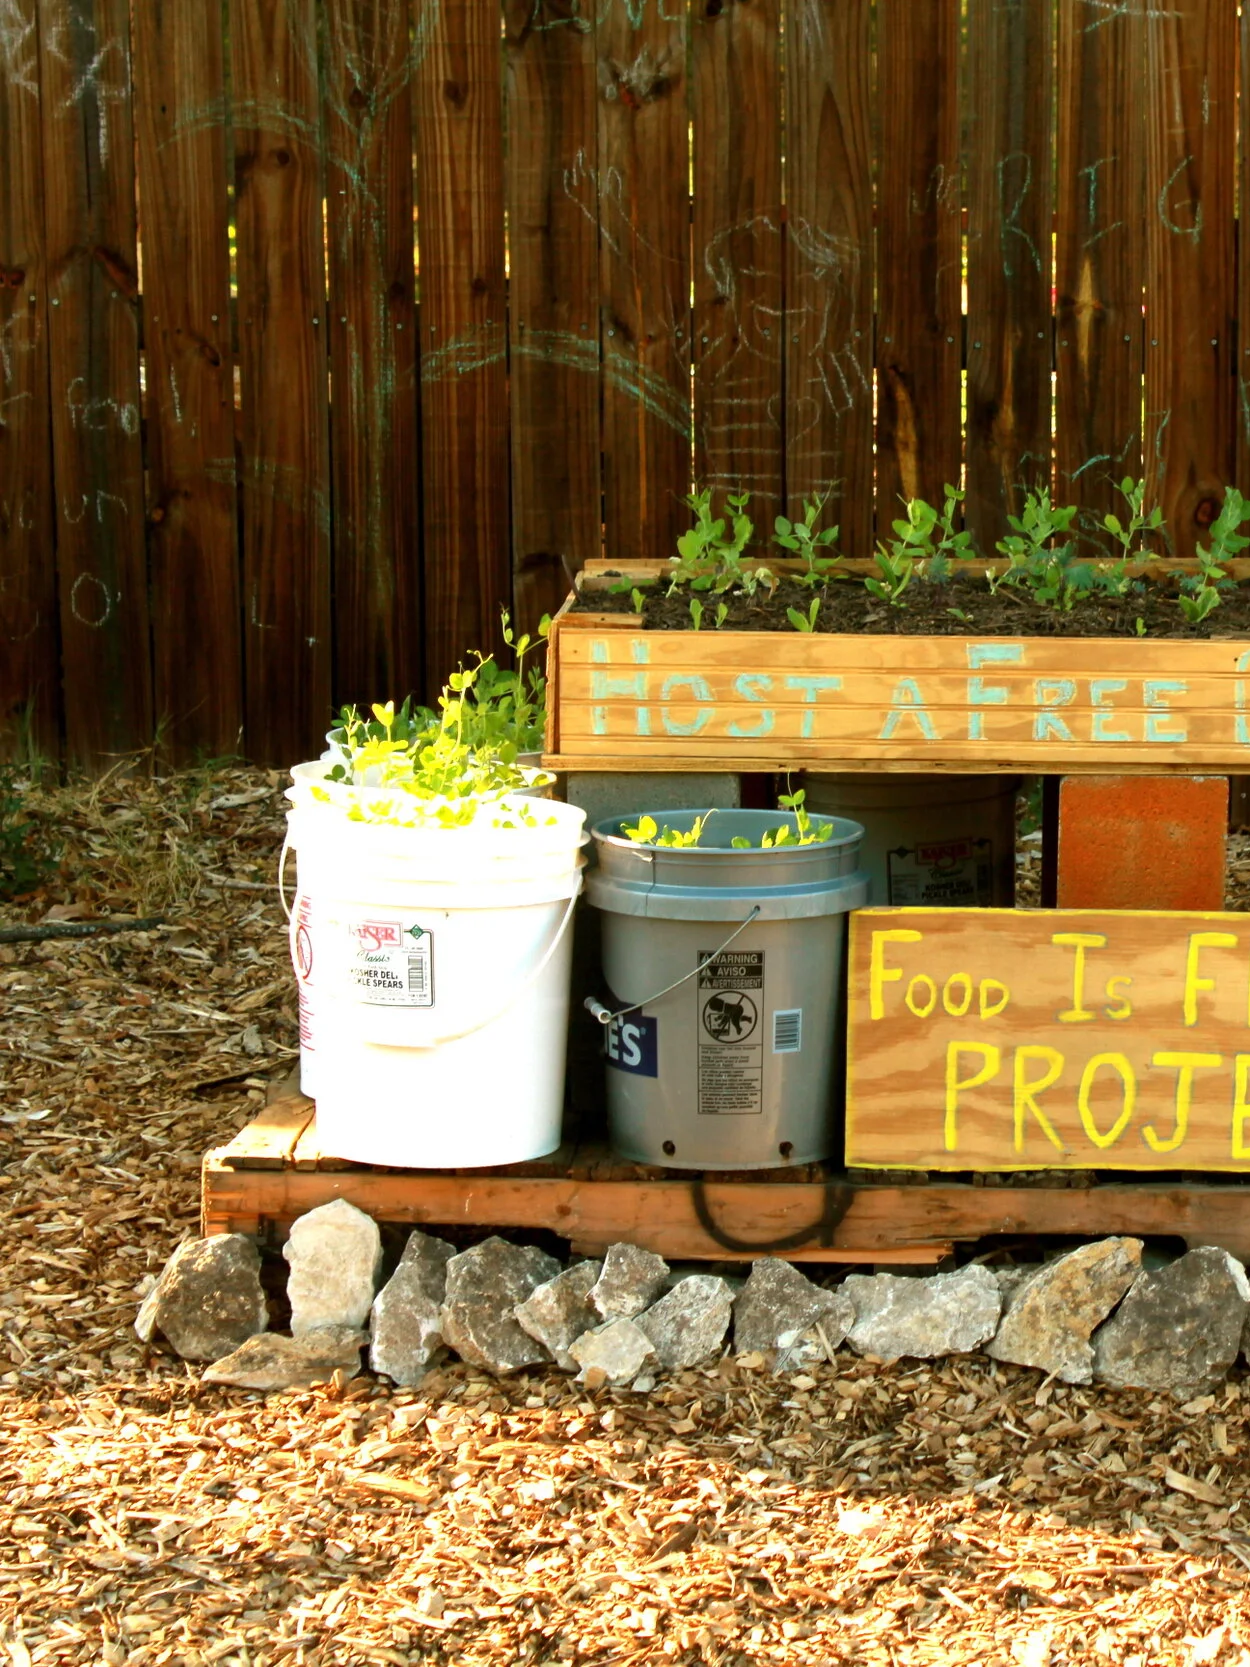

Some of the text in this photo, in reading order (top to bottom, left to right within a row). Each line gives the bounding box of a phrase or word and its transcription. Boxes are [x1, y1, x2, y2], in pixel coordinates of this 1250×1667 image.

[588, 638, 842, 738] HOST
[964, 641, 1190, 742] FREE
[712, 953, 758, 965] WARNING
[717, 966, 747, 976] AVISO
[869, 929, 1010, 1020] FOOD
[1052, 932, 1134, 1023] IS
[372, 979, 404, 989] SPEARS
